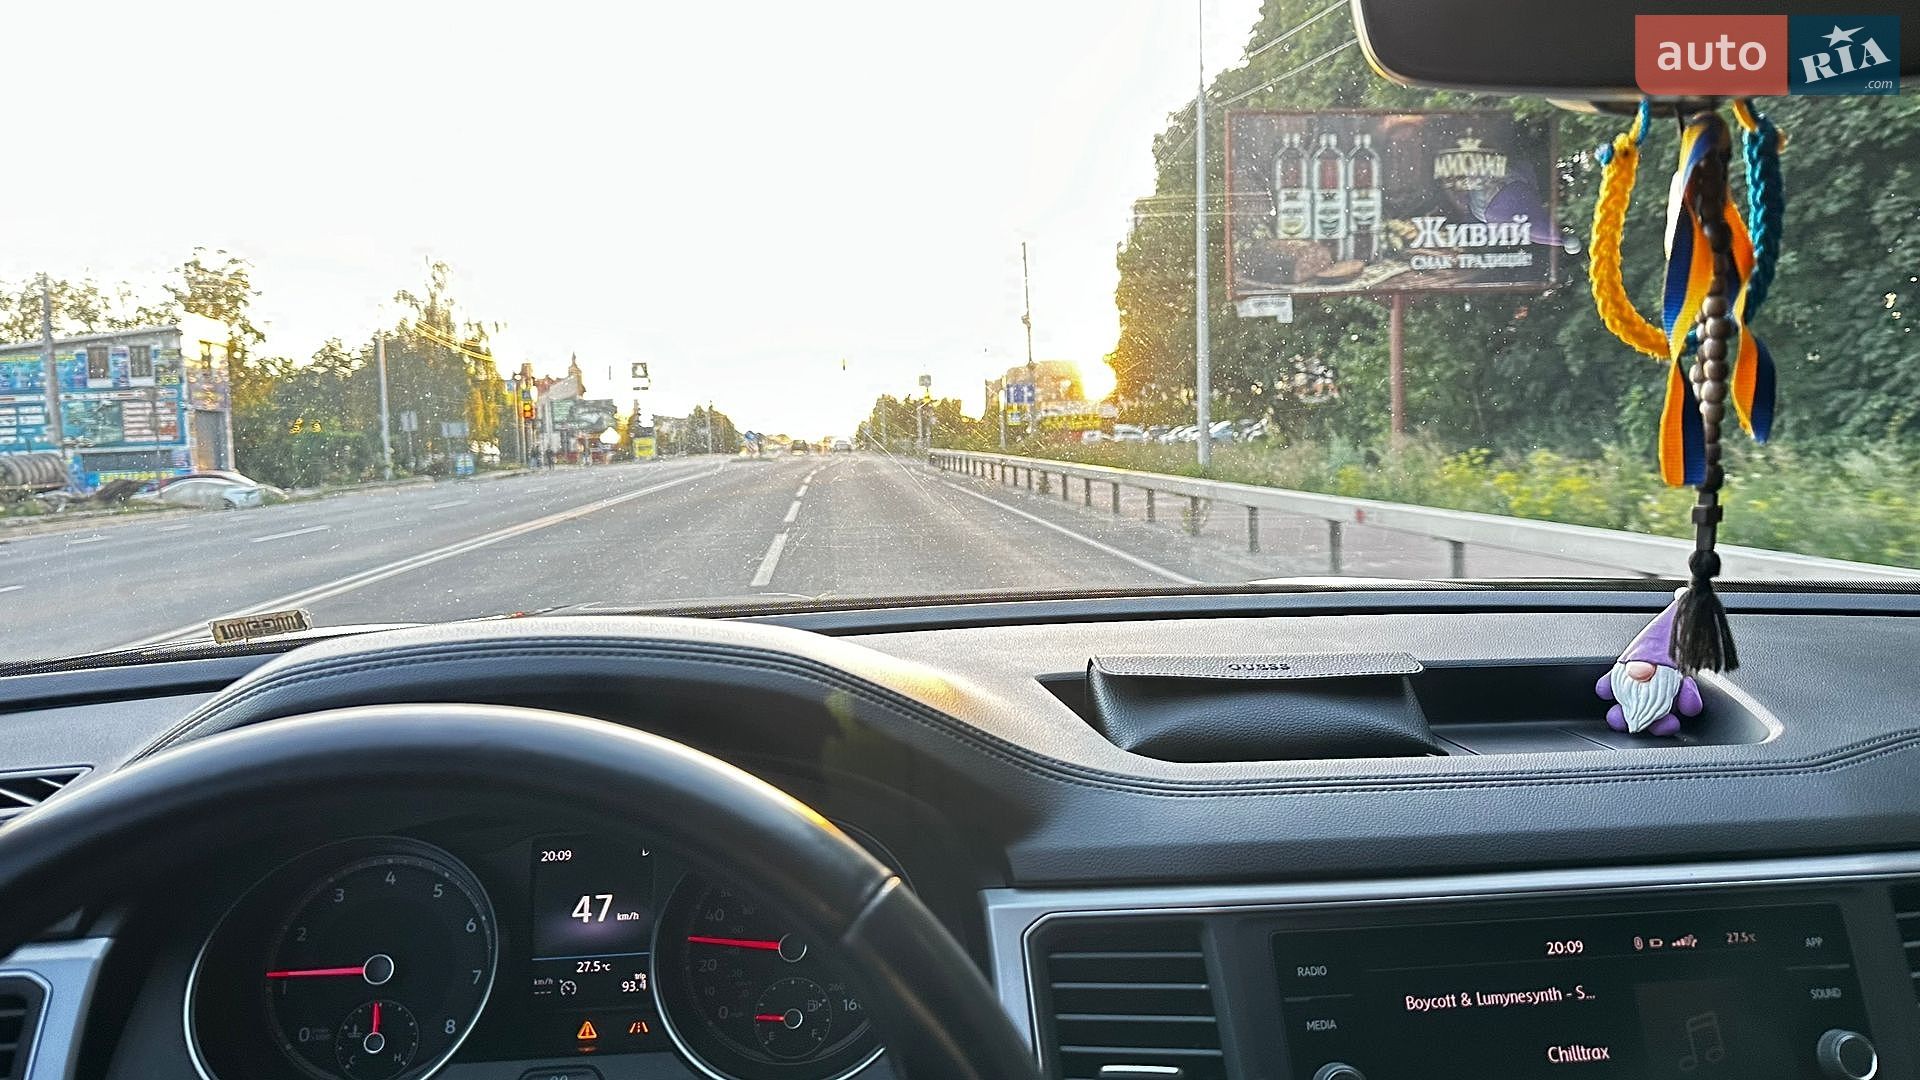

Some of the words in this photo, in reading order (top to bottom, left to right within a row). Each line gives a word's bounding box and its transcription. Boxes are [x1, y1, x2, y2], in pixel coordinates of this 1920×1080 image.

[1409, 214, 1532, 249] Живий
[541, 849, 572, 862] 20:09
[385, 871, 396, 885] 4
[334, 888, 345, 902] 3
[433, 884, 443, 898] 5
[571, 893, 614, 923] 47
[616, 911, 640, 921] km/h
[466, 918, 476, 932] 6
[297, 927, 306, 942] 2
[1546, 940, 1584, 955] 20:09
[471, 970, 482, 985] 7
[1297, 965, 1328, 977] RADIO
[1405, 993, 1457, 1012] Boycott
[1461, 992, 1472, 1006] &
[1476, 987, 1562, 1007] Lumynesynth
[718, 1006, 729, 1019] 0
[445, 1019, 456, 1034] 8
[1306, 1019, 1337, 1031] MEDIA
[299, 1027, 310, 1042] 0
[1547, 1045, 1610, 1063] Chilltrax
